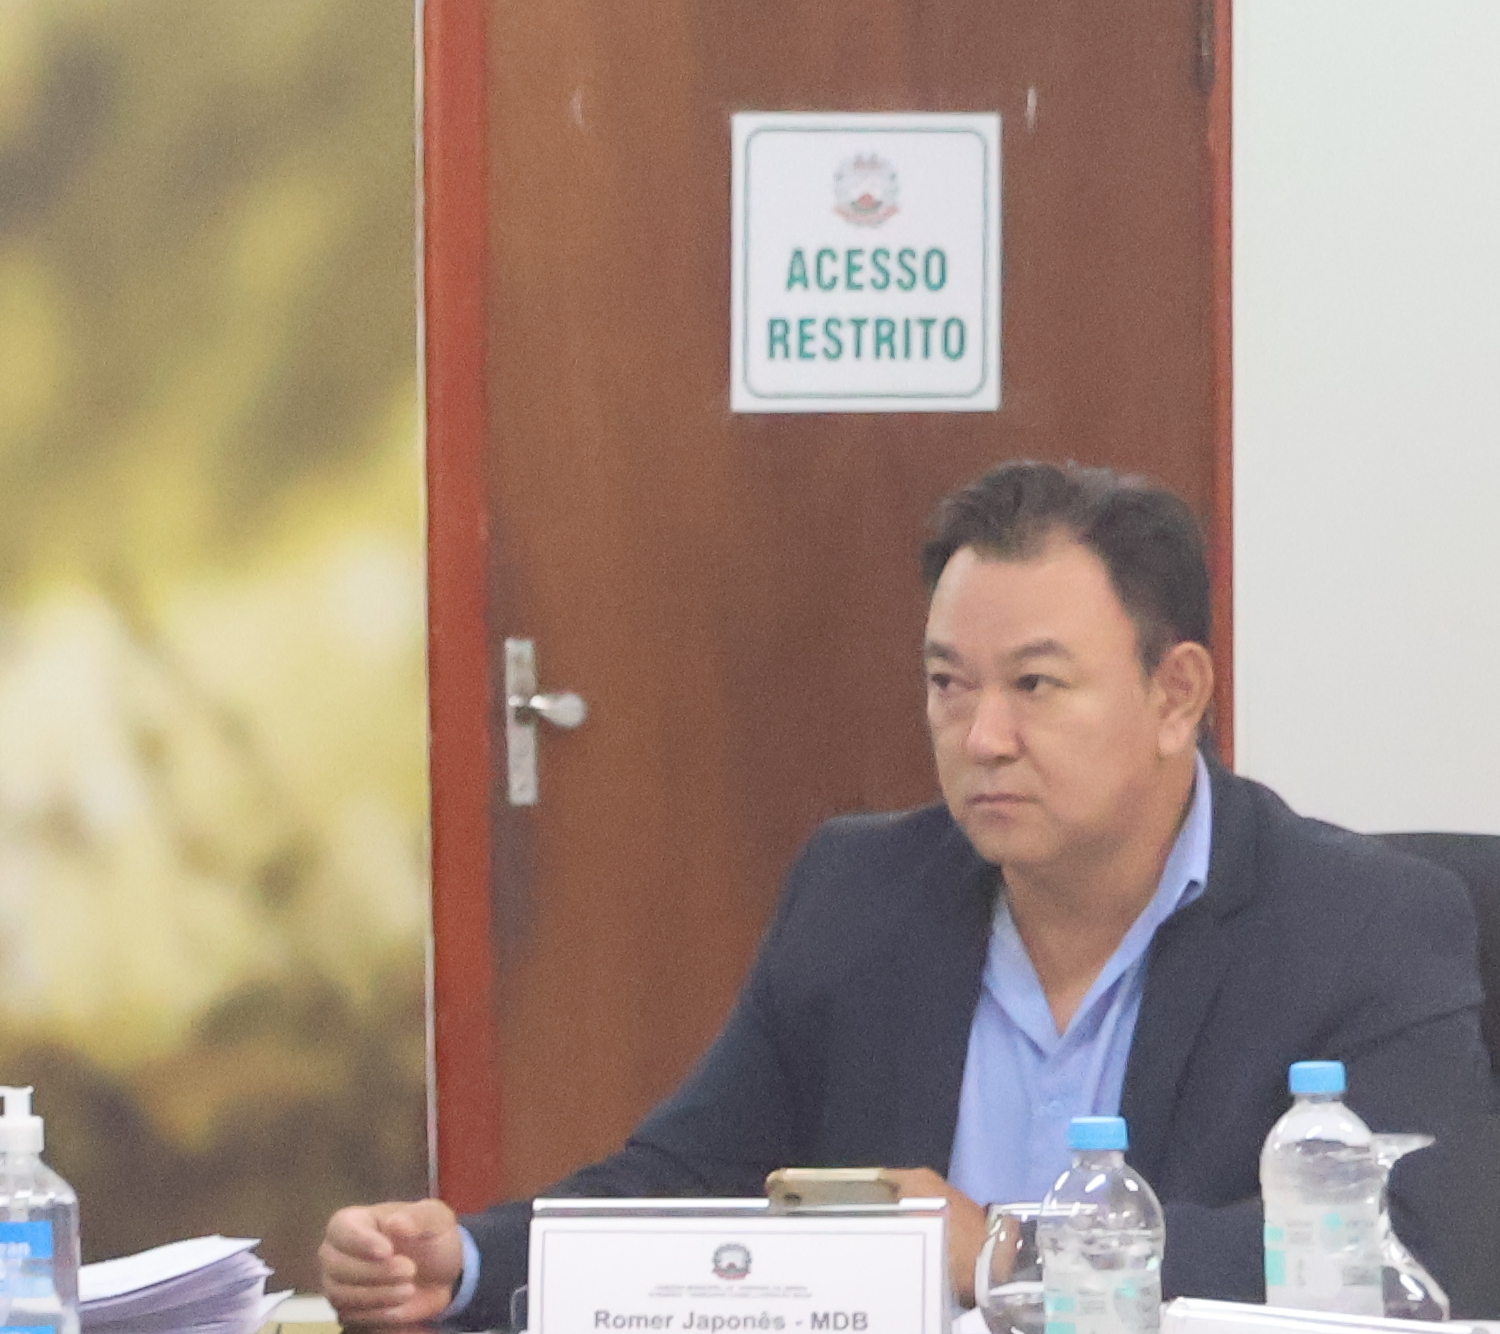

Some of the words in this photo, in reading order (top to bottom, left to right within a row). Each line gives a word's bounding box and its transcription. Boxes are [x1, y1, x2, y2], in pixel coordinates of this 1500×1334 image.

[785, 248, 948, 293] ACESSO
[767, 317, 967, 362] RESTRITO
[594, 1310, 674, 1330] Romer
[682, 1311, 786, 1334] Japonês
[810, 1310, 869, 1331] MDB
